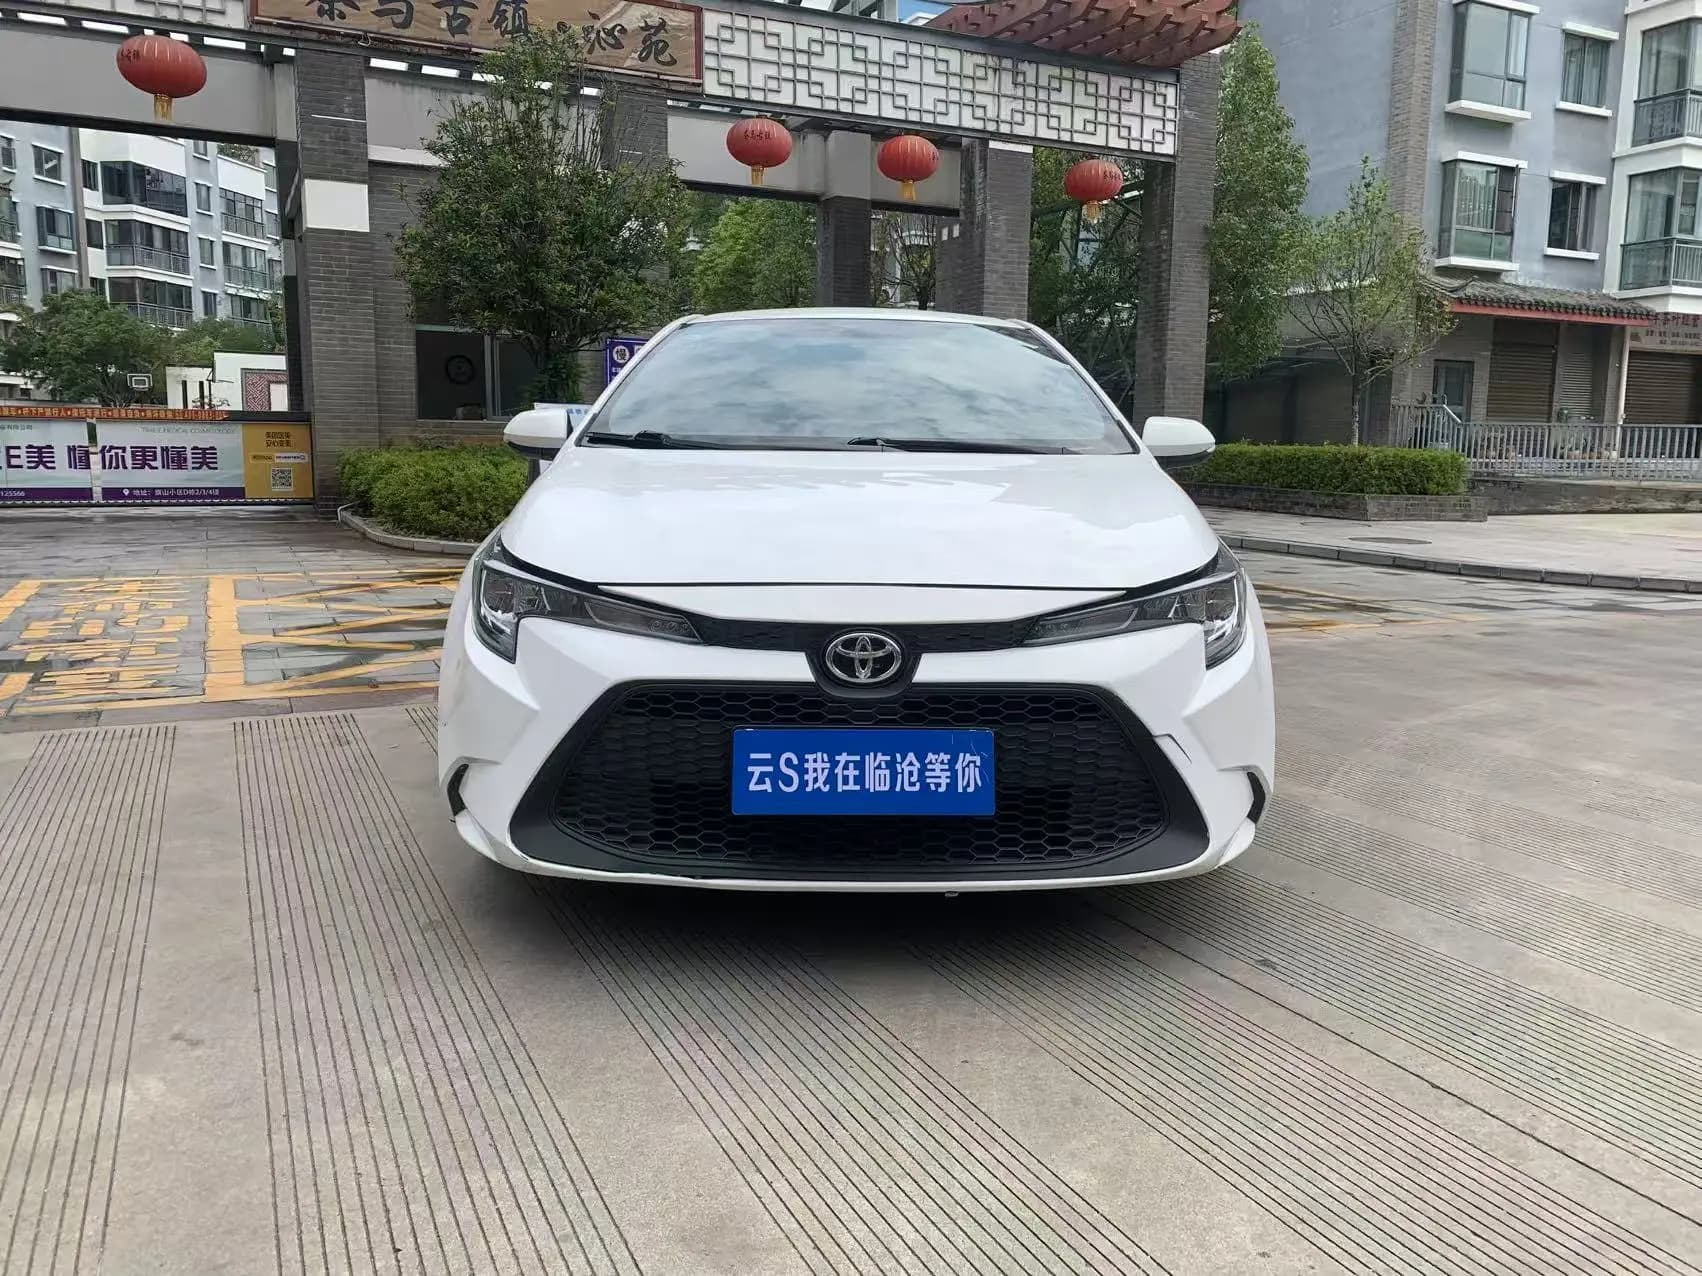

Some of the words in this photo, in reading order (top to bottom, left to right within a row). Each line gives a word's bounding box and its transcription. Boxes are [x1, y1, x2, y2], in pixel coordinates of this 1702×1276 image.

[747, 752, 982, 793] 云S我在临沧等你
